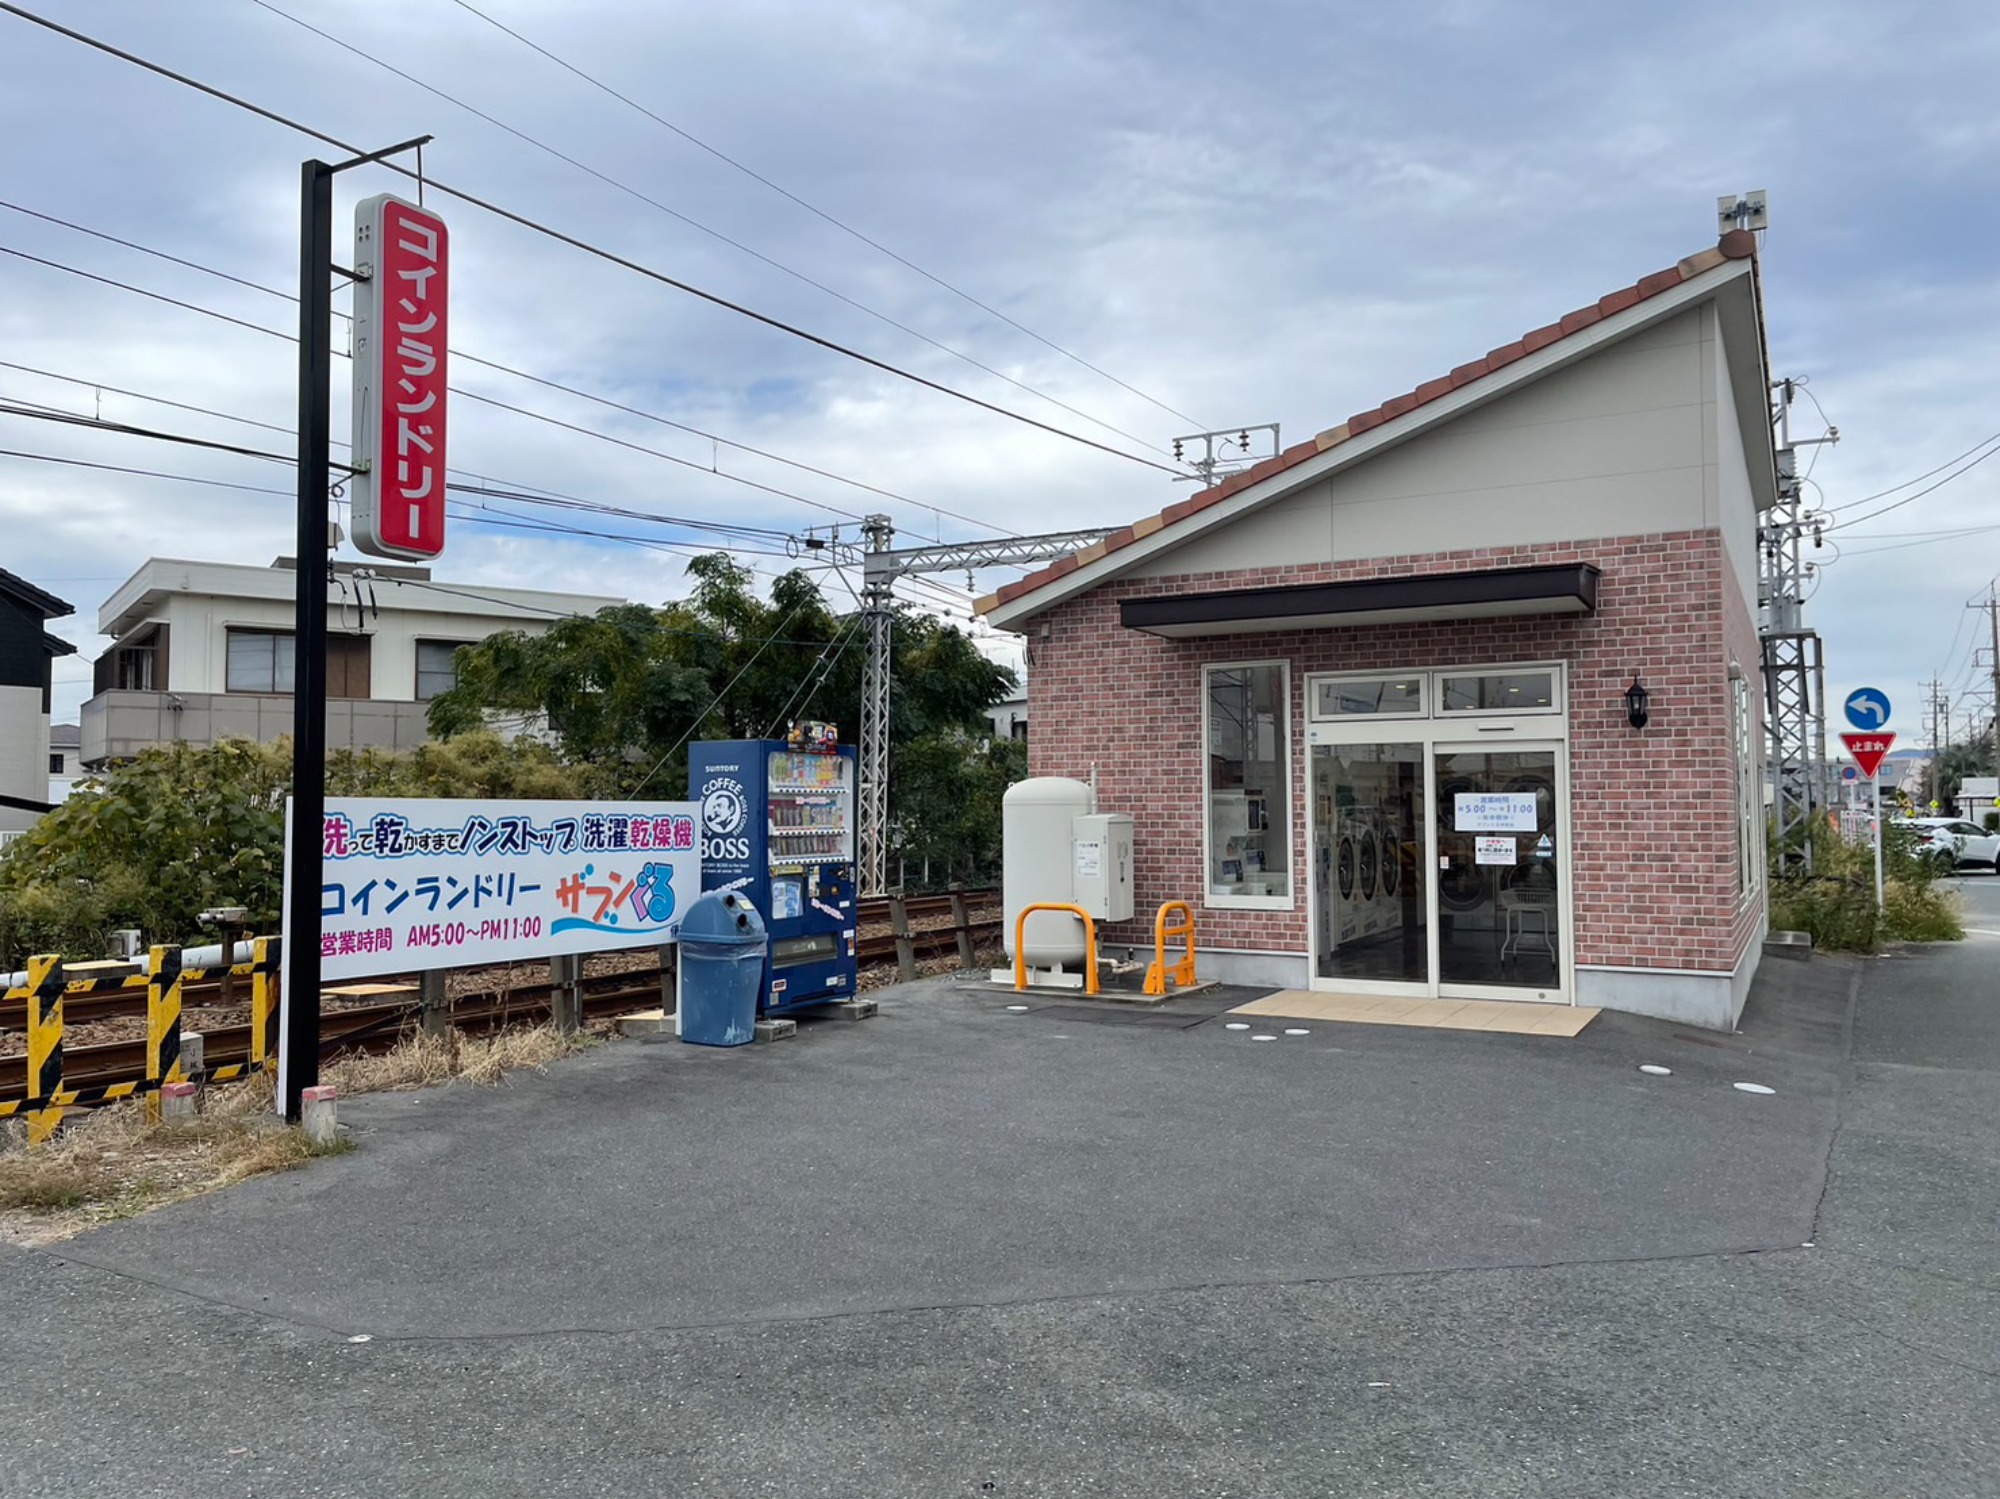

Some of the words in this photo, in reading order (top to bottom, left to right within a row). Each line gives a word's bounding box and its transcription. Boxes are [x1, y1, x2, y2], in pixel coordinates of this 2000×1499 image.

[397, 216, 438, 539] コインランドリー
[1852, 740, 1885, 752] 止まれ
[705, 765, 739, 773] SUNTORY
[702, 777, 743, 796] COFFEE
[582, 816, 693, 850] 洗濯乾燥機
[701, 837, 750, 860] BOSS
[321, 872, 541, 916] コインランドリー
[321, 927, 393, 957] 営業時間
